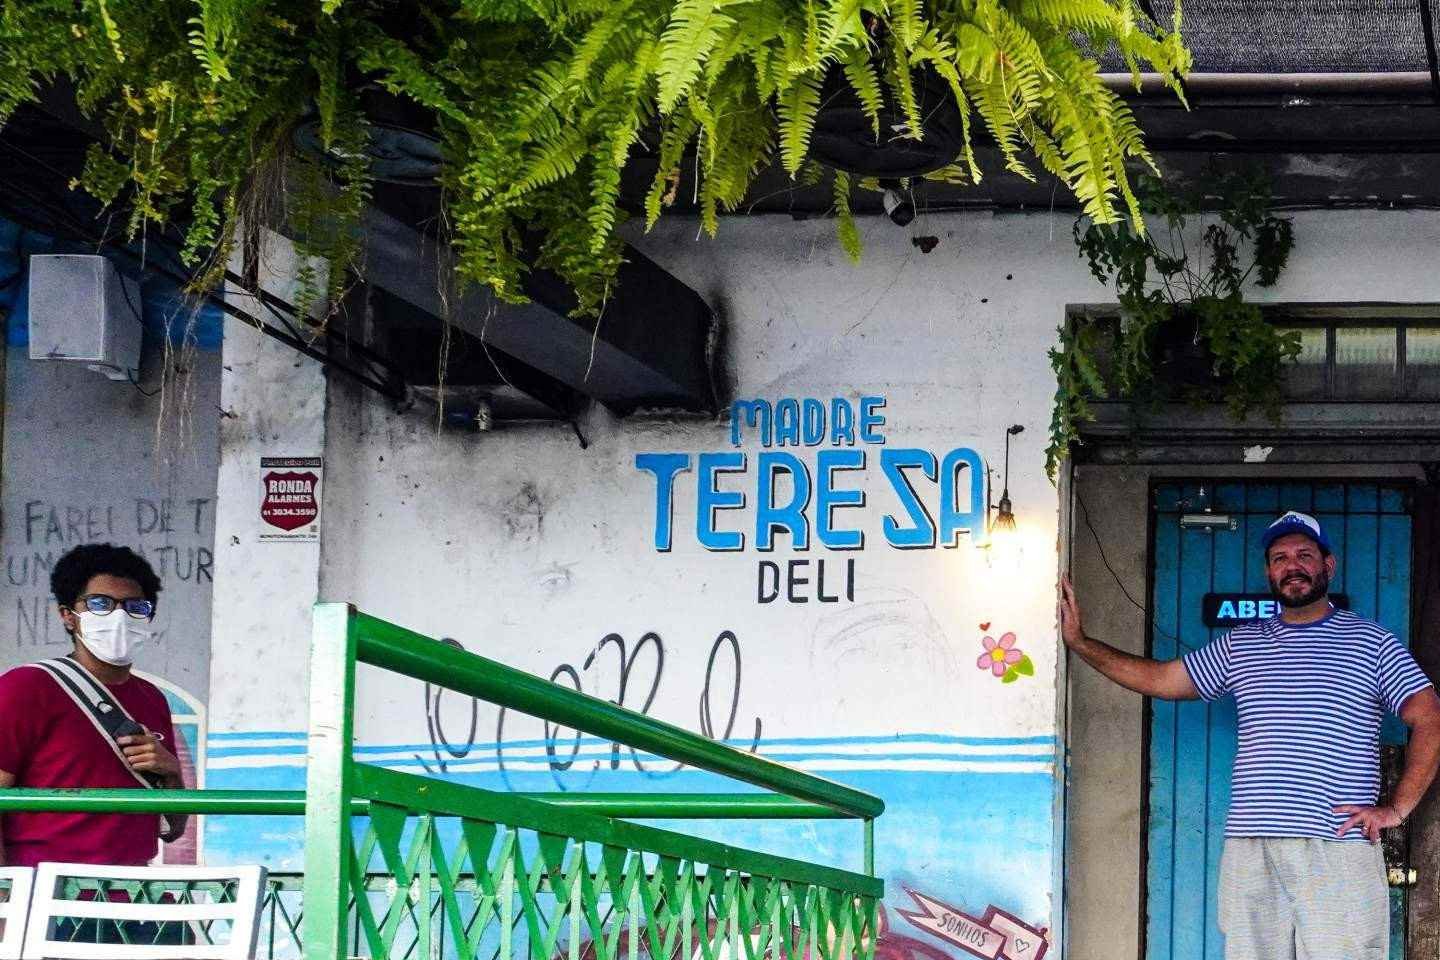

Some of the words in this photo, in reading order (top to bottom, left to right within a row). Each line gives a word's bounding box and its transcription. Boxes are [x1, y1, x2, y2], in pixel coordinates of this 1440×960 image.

[730, 396, 888, 448] MADRE
[268, 495, 312, 503] ALARMES
[269, 480, 312, 493] RONDA
[635, 447, 990, 553] TERESA
[757, 558, 856, 605] DELI
[1217, 600, 1281, 619] ABE
